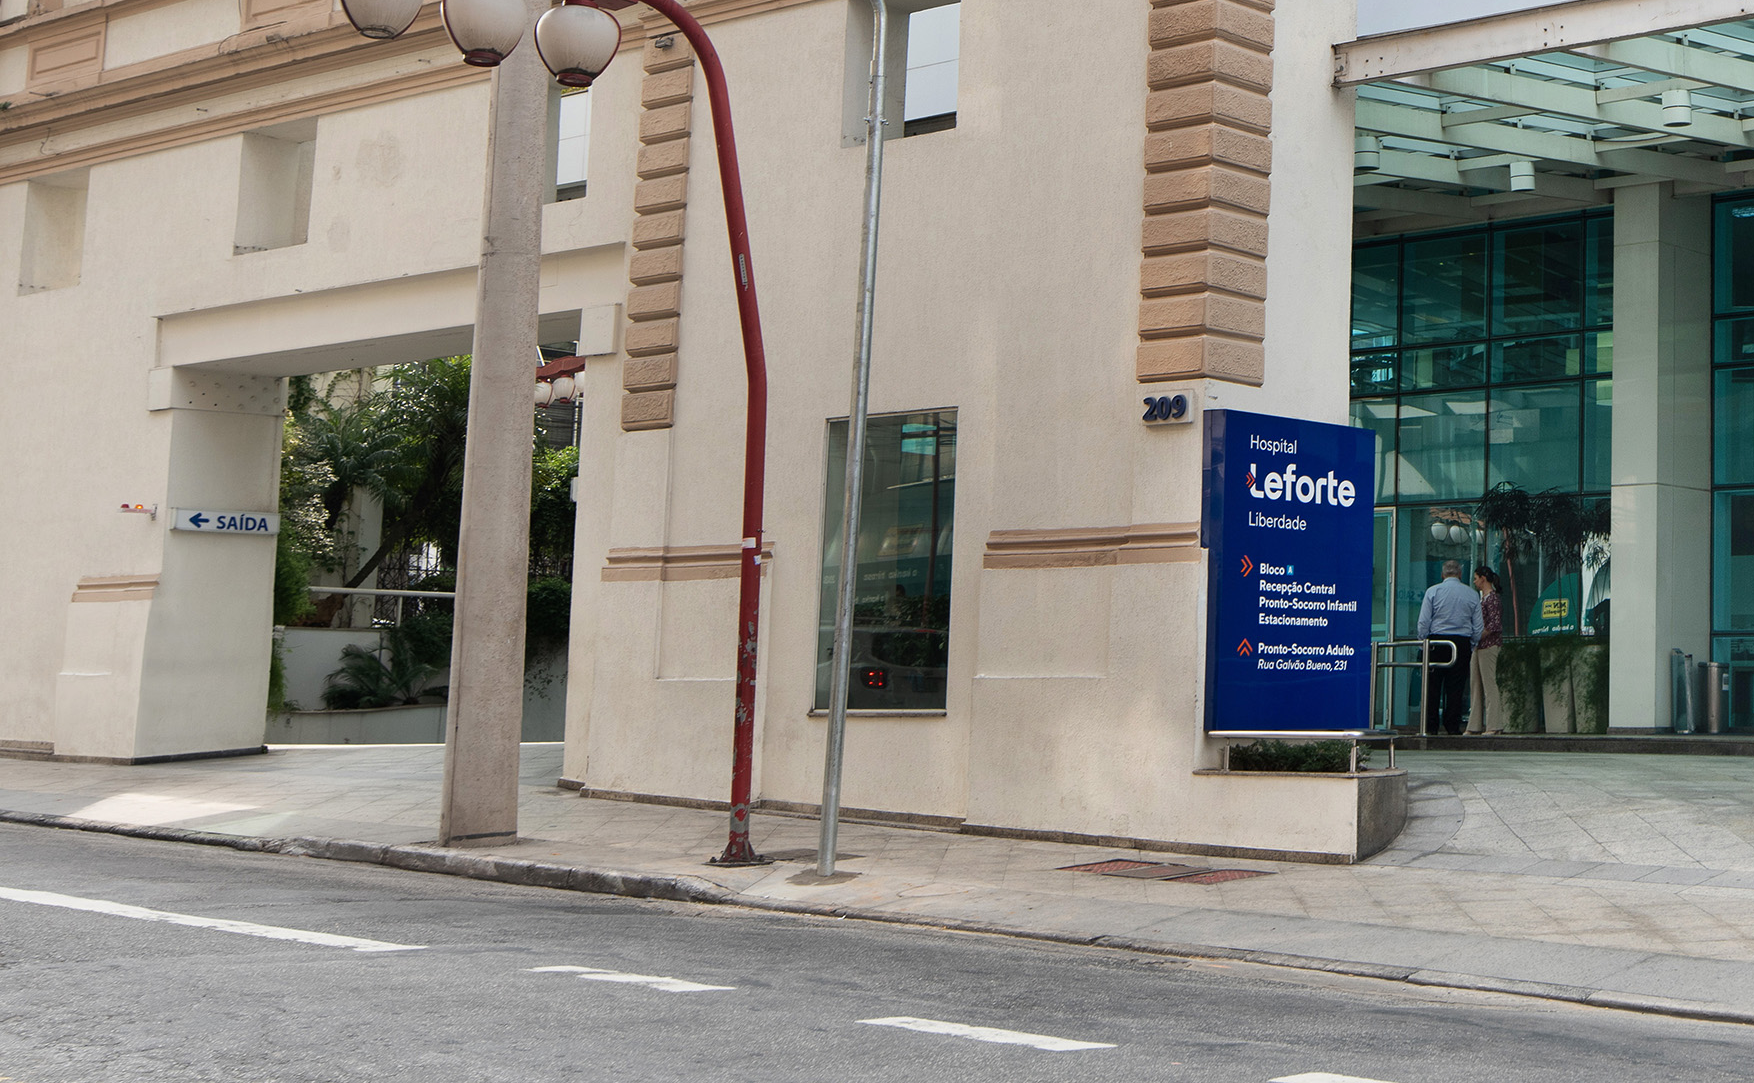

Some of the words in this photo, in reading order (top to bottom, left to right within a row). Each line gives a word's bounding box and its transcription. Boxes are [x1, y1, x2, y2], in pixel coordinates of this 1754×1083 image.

[1142, 394, 1187, 421] 209
[1250, 434, 1297, 455] Hospital
[1249, 463, 1356, 508] Leforte
[216, 514, 269, 532] SAÍDA
[1248, 511, 1307, 531] Liberdade
[1259, 563, 1285, 576] Bloco
[1287, 566, 1294, 575] A
[1259, 579, 1302, 595] Recepção
[1304, 582, 1336, 595] Central
[1258, 596, 1326, 611] Pronto-Socorro
[1327, 599, 1357, 612] Infantil
[1258, 613, 1328, 627] Estacionamento
[1258, 642, 1325, 656] Pronto-Socorro
[1326, 645, 1355, 656] Adulto
[1257, 659, 1274, 670] Rua
[1275, 659, 1305, 670] Galvão
[1306, 660, 1333, 672] Bueno,
[1334, 660, 1348, 671] 231
